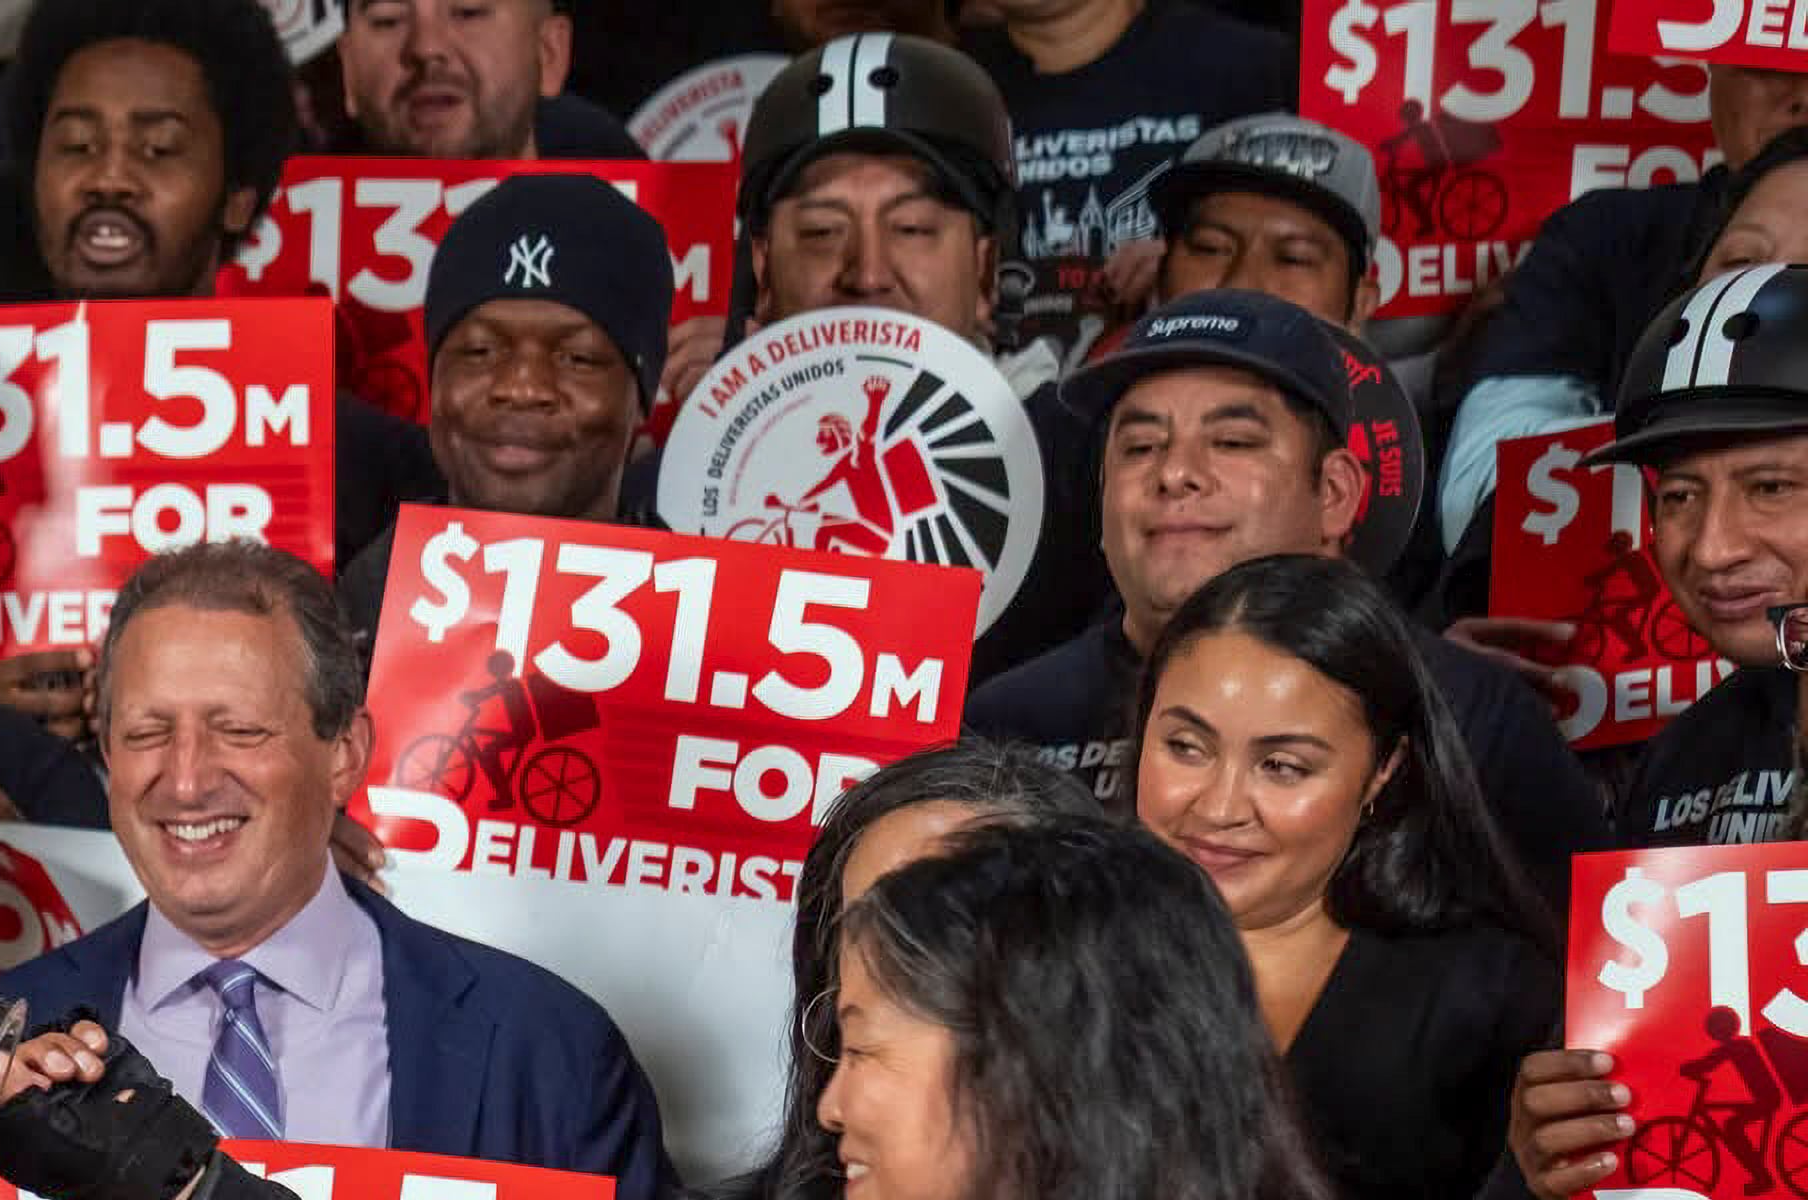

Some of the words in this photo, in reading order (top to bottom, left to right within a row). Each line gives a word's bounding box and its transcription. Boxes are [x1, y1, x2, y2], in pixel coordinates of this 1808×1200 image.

[1571, 144, 1725, 201] FO
[504, 234, 555, 289] NY
[1147, 315, 1239, 337] Supreme
[699, 402, 718, 419] I
[710, 366, 748, 411] AM
[746, 356, 766, 379] A
[766, 318, 922, 366] DELIVERISTA
[782, 358, 846, 393] UNIDOS
[706, 381, 782, 480] DELIVERISTAS
[76, 483, 273, 557] FOR
[703, 485, 718, 518] LOS
[409, 522, 944, 725] $131.5M
[1654, 789, 1712, 832] LOS
